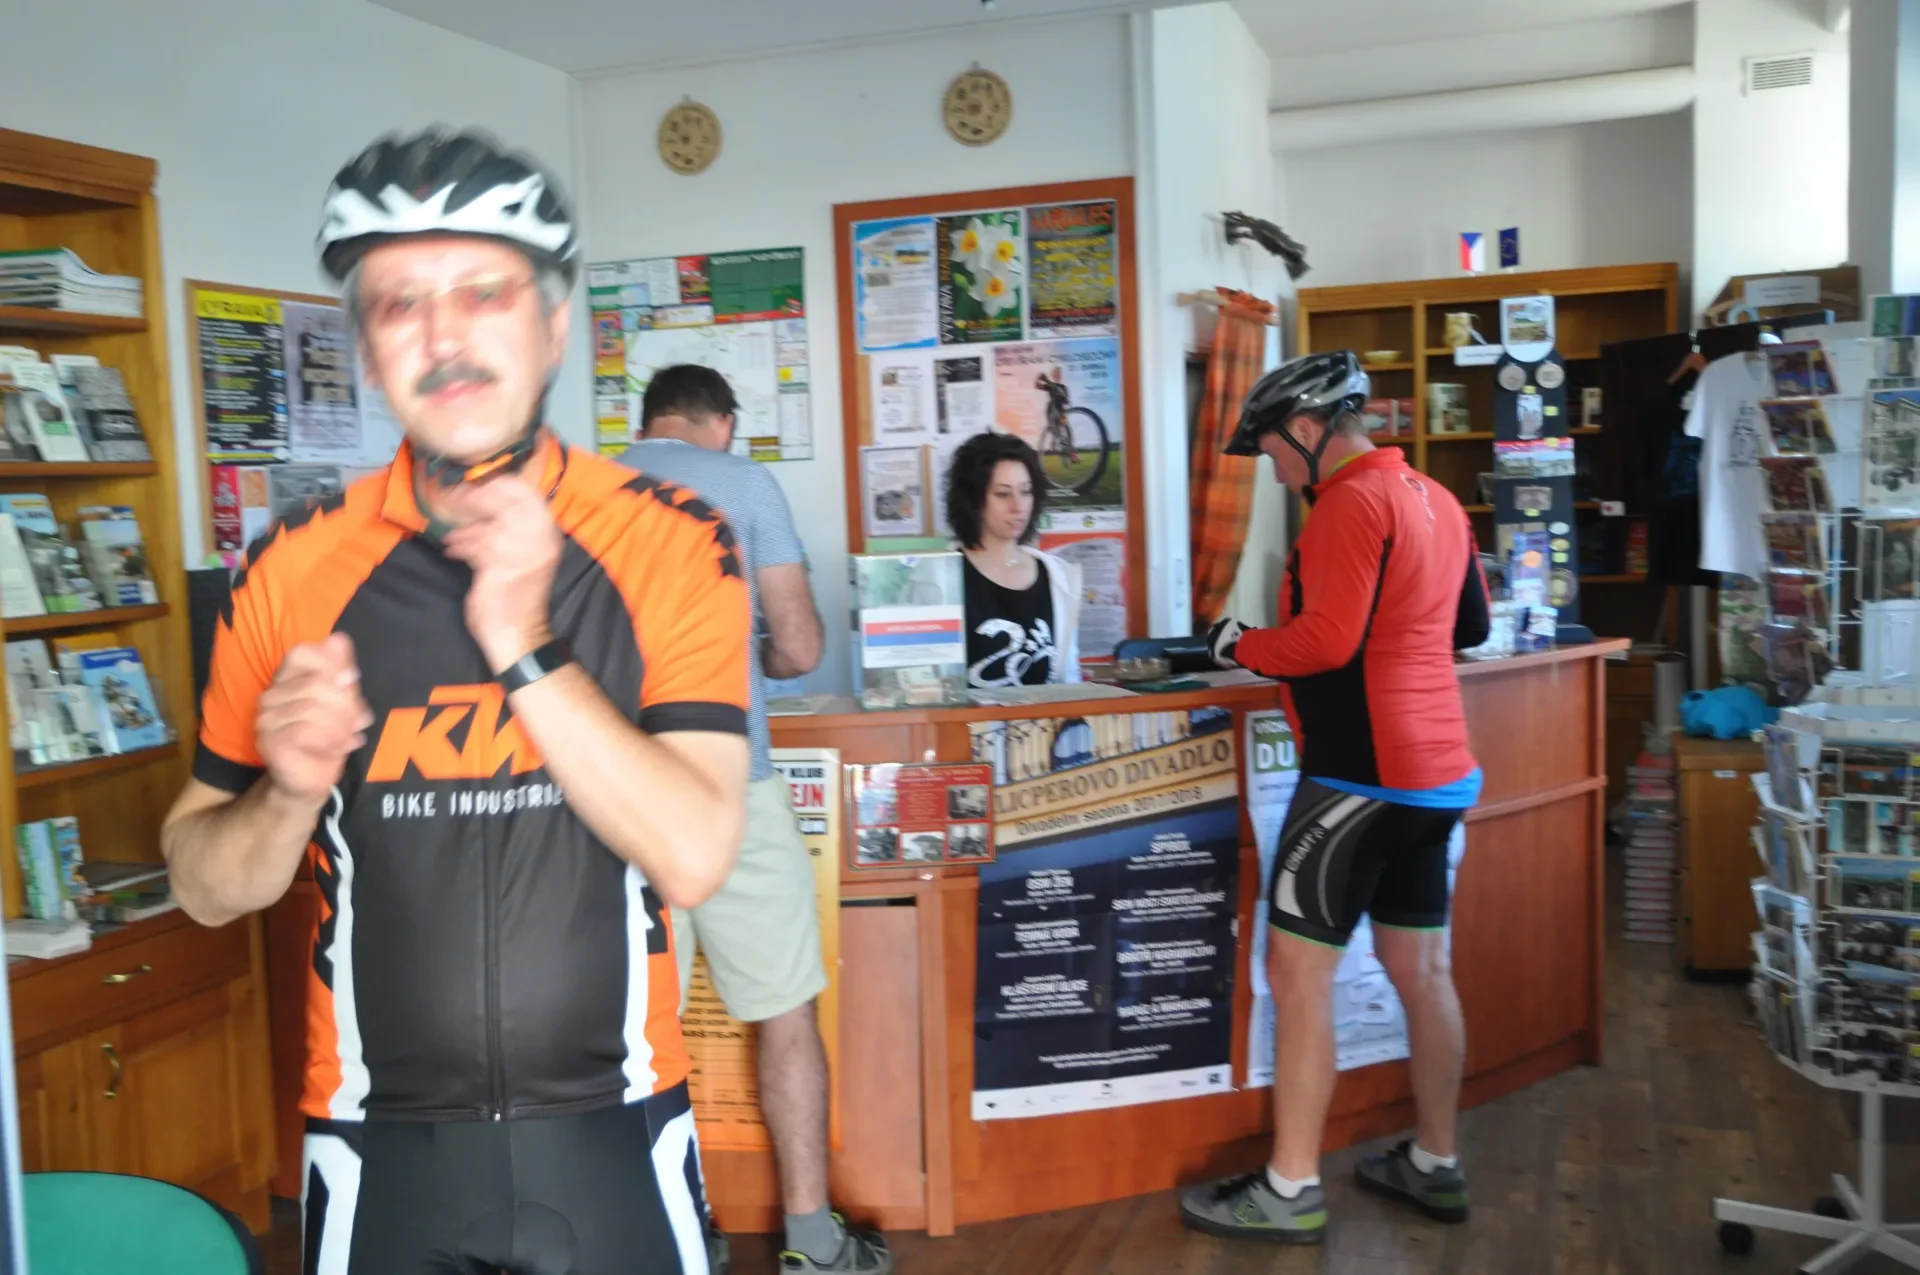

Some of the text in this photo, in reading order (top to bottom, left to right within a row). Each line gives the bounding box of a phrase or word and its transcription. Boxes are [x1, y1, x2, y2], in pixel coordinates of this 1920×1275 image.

[998, 739, 1230, 814] LICPEROVO DIVADLO
[382, 791, 436, 818] BIKE
[789, 784, 825, 807] EJN
